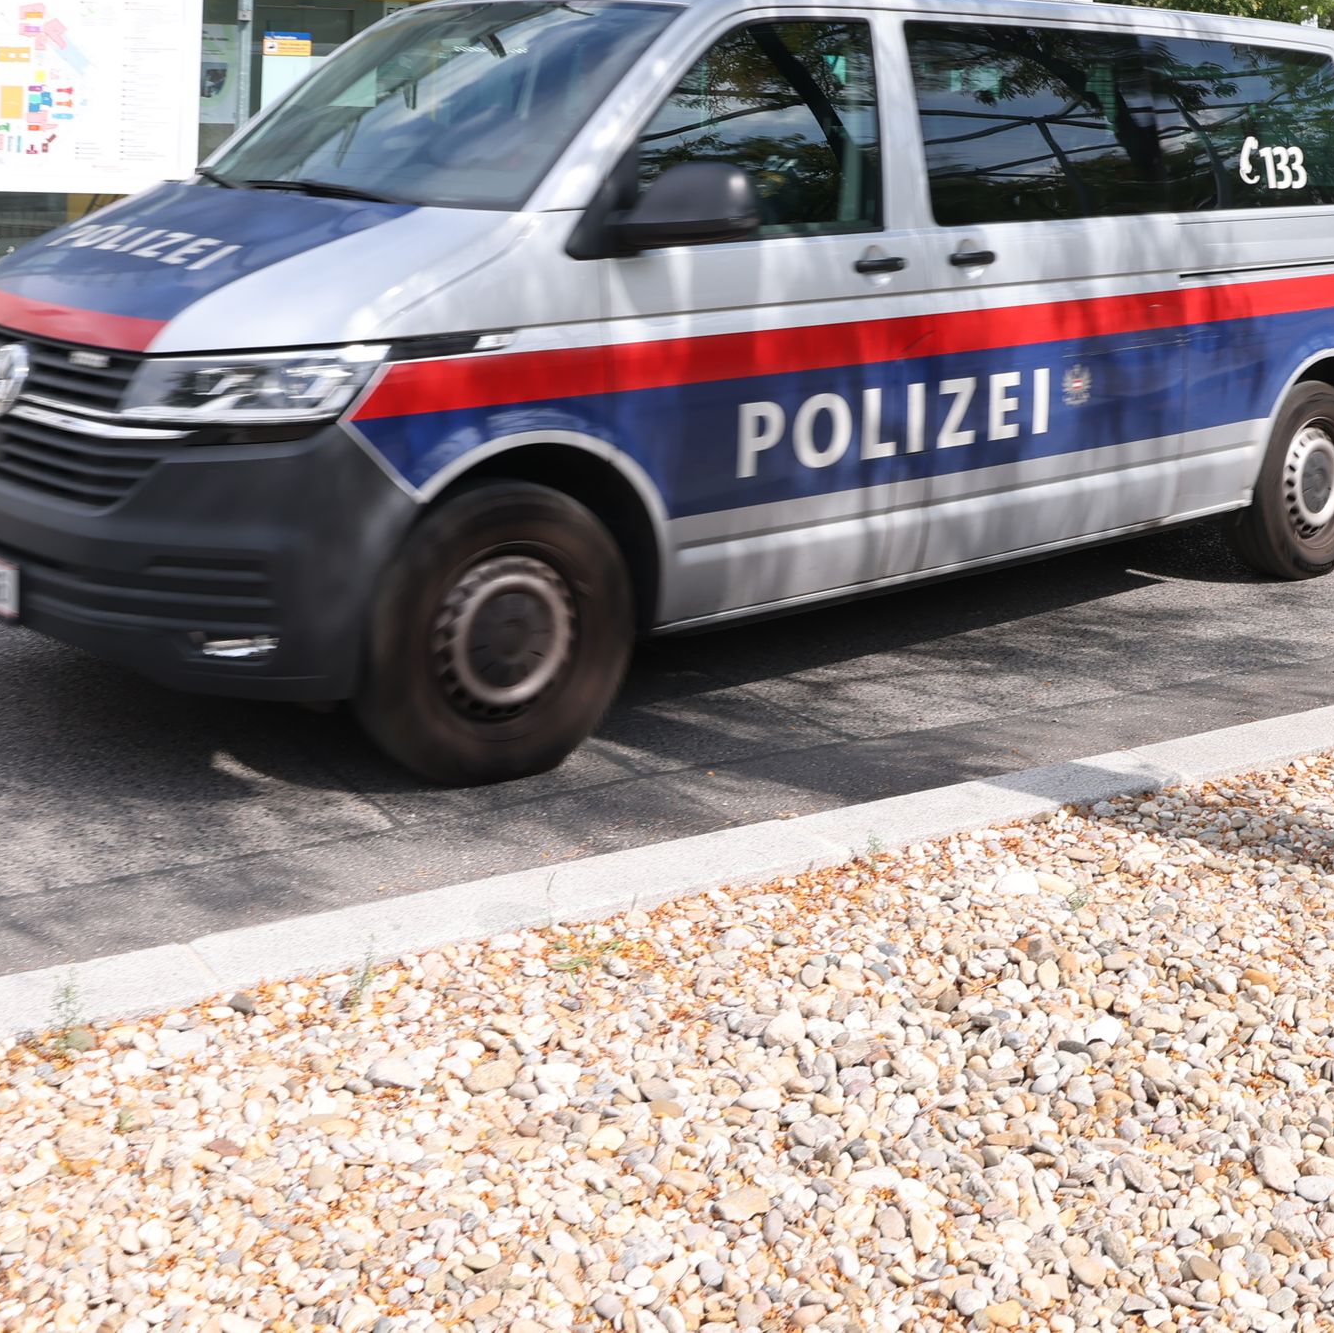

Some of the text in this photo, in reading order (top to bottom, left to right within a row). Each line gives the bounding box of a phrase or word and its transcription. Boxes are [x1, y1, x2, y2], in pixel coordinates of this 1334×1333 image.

[1258, 146, 1308, 189] 133
[43, 223, 244, 270] POLIZEI
[735, 367, 1051, 479] POLIZEI
